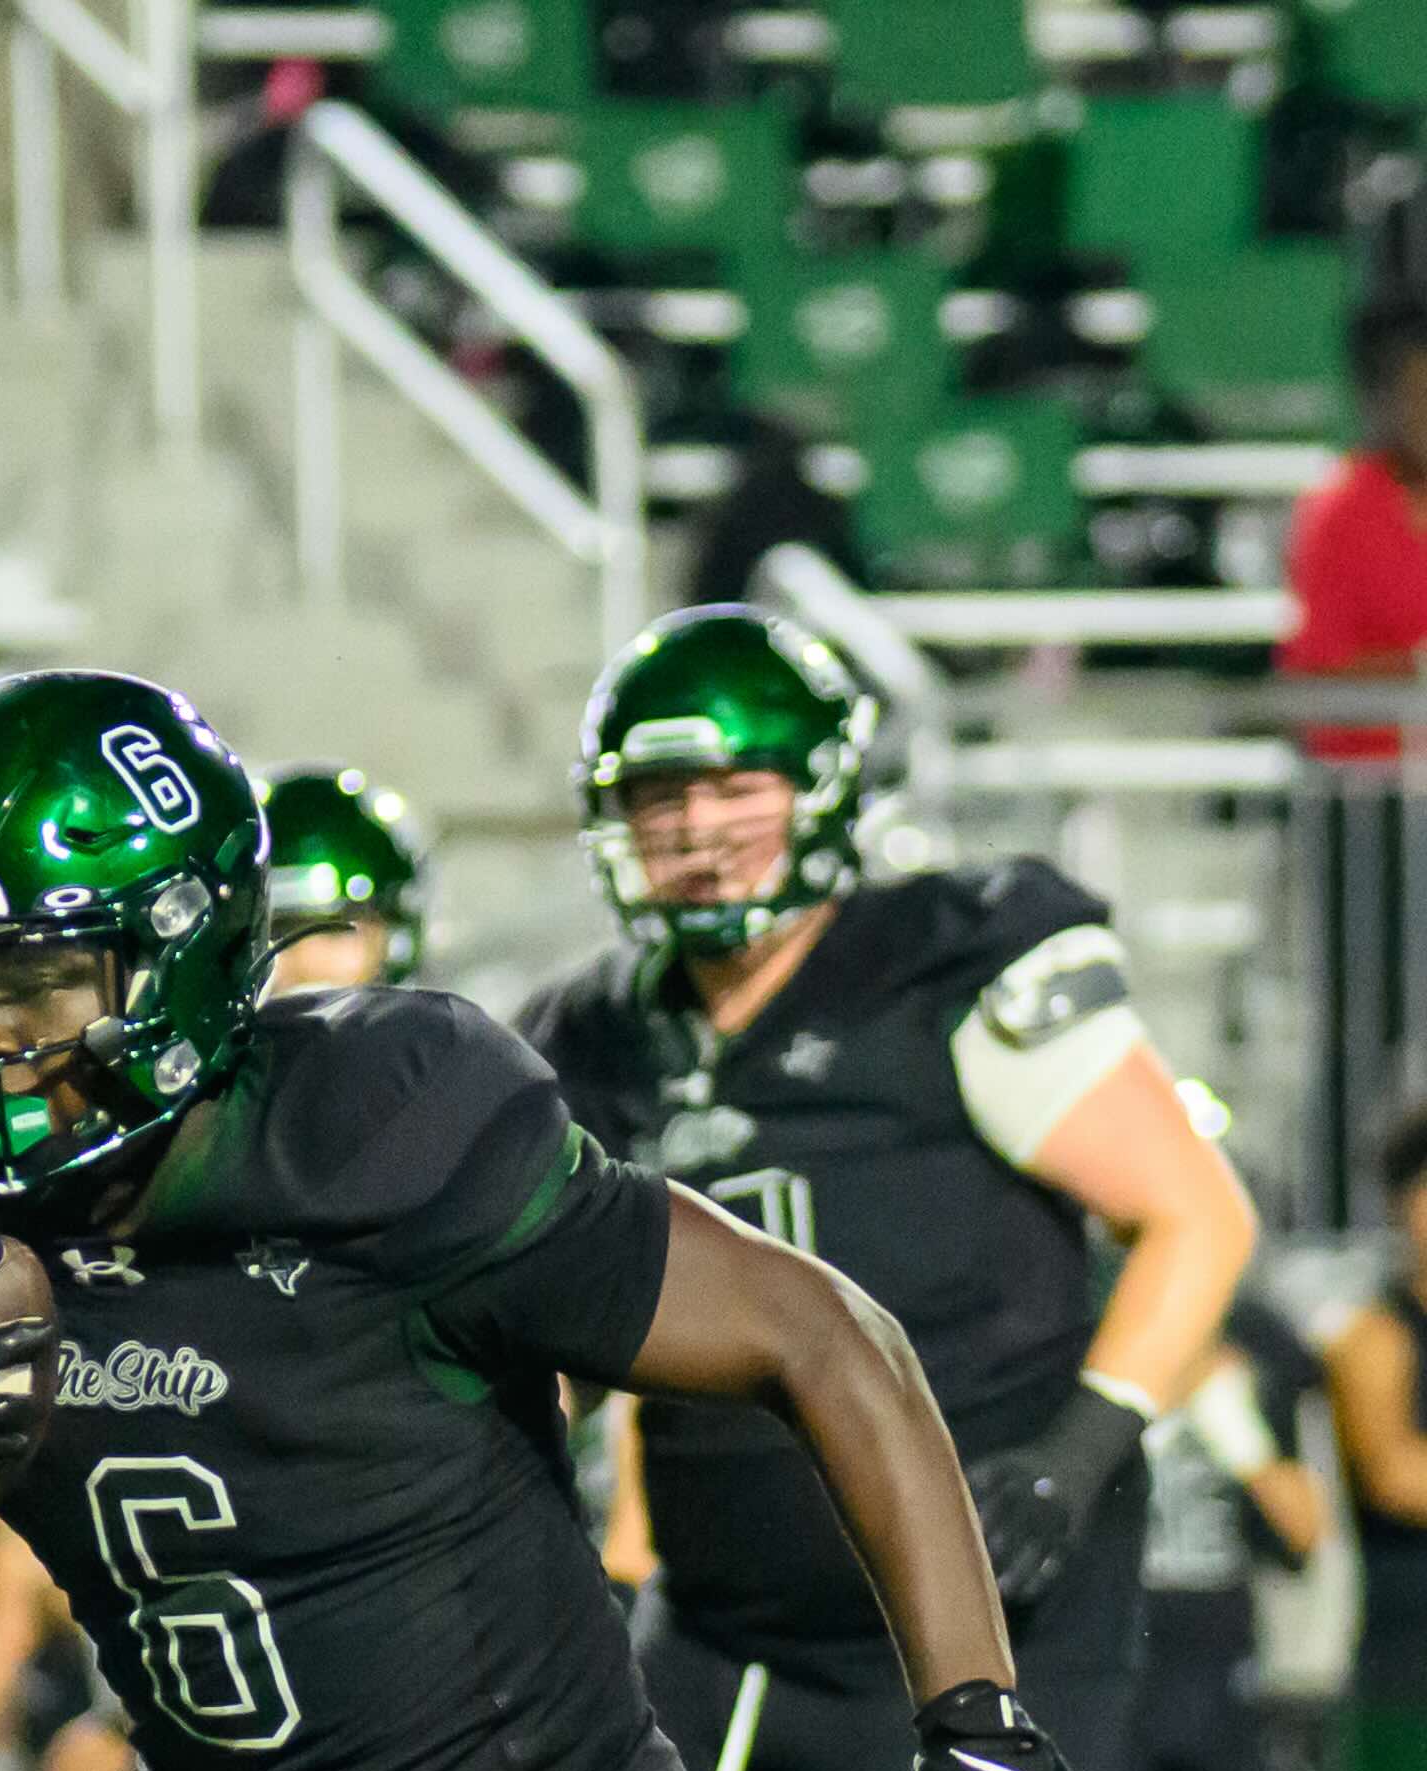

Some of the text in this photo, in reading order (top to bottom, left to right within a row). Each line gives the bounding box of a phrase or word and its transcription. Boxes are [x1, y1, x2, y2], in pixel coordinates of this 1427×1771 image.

[101, 724, 201, 834] 6
[105, 1340, 228, 1416] Ship
[86, 1456, 301, 1749] 6
